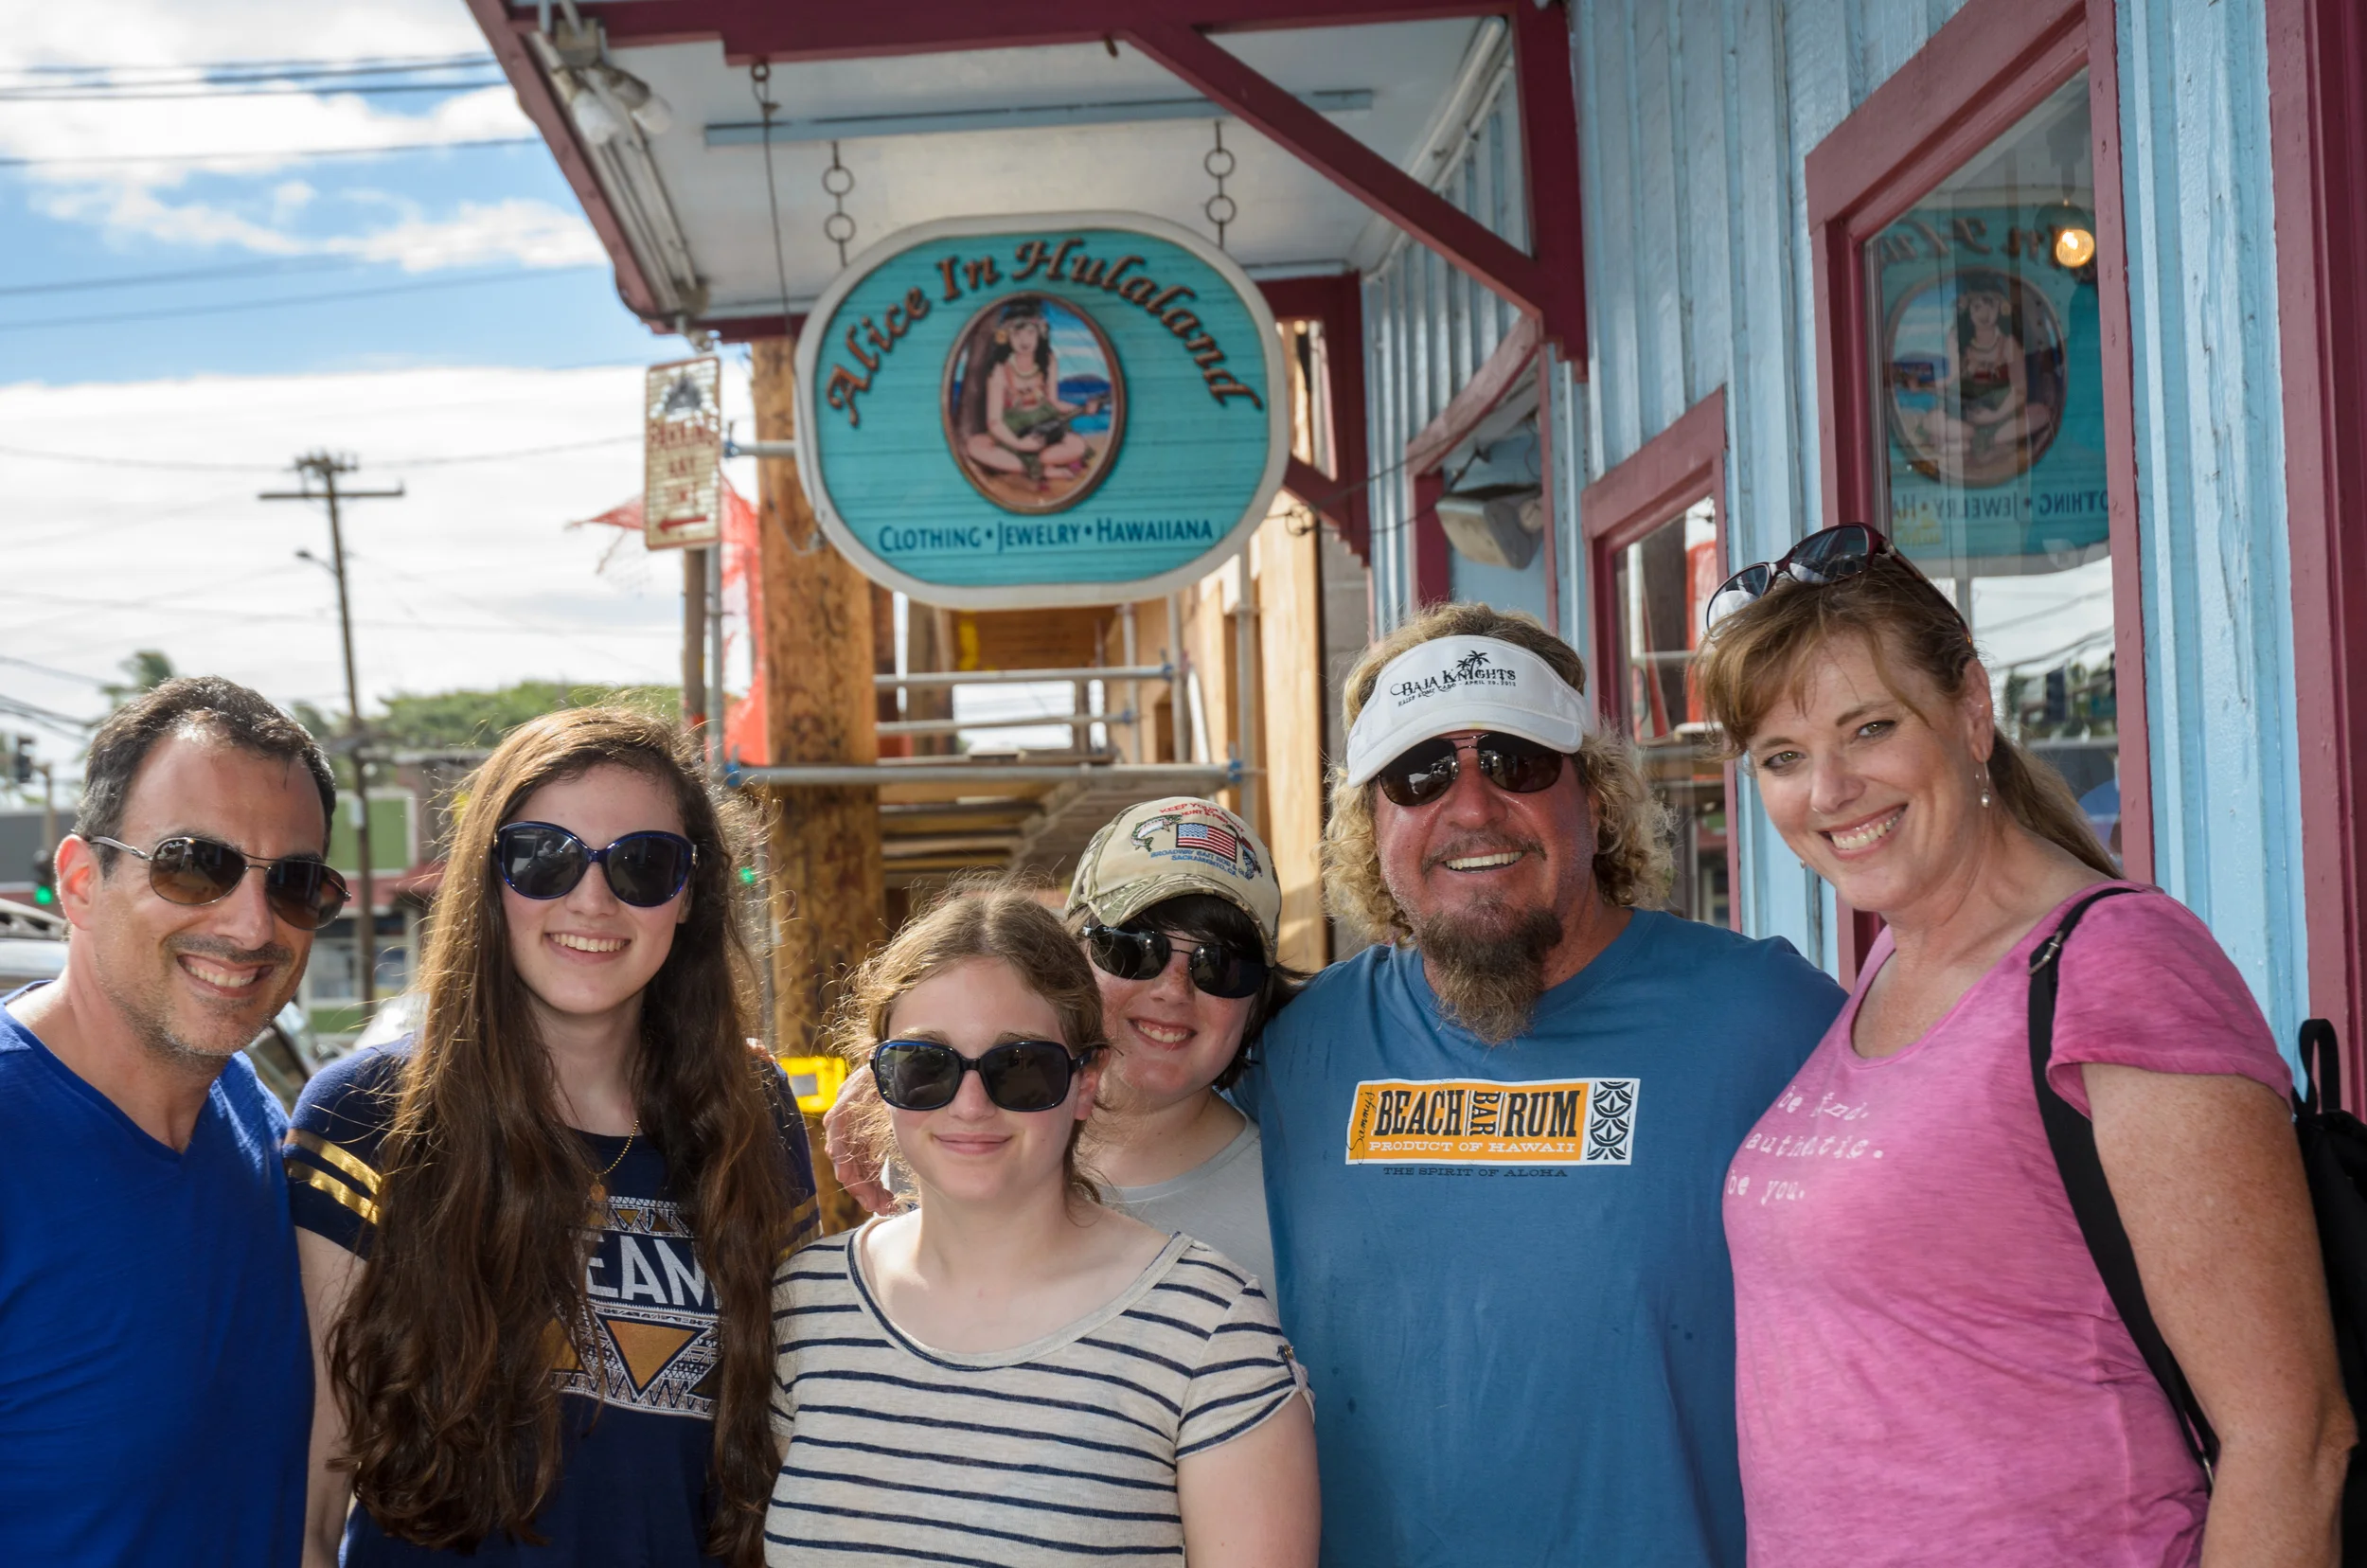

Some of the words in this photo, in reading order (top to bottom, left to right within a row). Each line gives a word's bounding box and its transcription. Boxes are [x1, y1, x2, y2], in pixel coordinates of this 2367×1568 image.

[827, 283, 930, 427] Alice
[935, 254, 1002, 302] In
[1012, 237, 1263, 411] Hulaland
[879, 525, 982, 552] CLOTHING
[997, 522, 1081, 552] JEWELRY
[1096, 517, 1213, 543] HAWAIIANA
[1390, 676, 1439, 696] BAJA
[1442, 666, 1516, 684] KNIGHTS
[1159, 803, 1187, 813] KEEP
[1150, 848, 1194, 858] BROADWAY
[1371, 1089, 1465, 1137] BEACH
[1470, 1091, 1499, 1136] BAR
[1502, 1090, 1580, 1137] RUM
[1368, 1141, 1454, 1152] PRODUCT
[1458, 1142, 1483, 1152] OF
[1487, 1142, 1575, 1153] HAWAII
[1382, 1167, 1415, 1176] THE
[1418, 1167, 1473, 1177] SPIRIT
[1478, 1167, 1499, 1177] OF
[1504, 1168, 1568, 1177] ALOHA
[1761, 1181, 1806, 1205] you.
